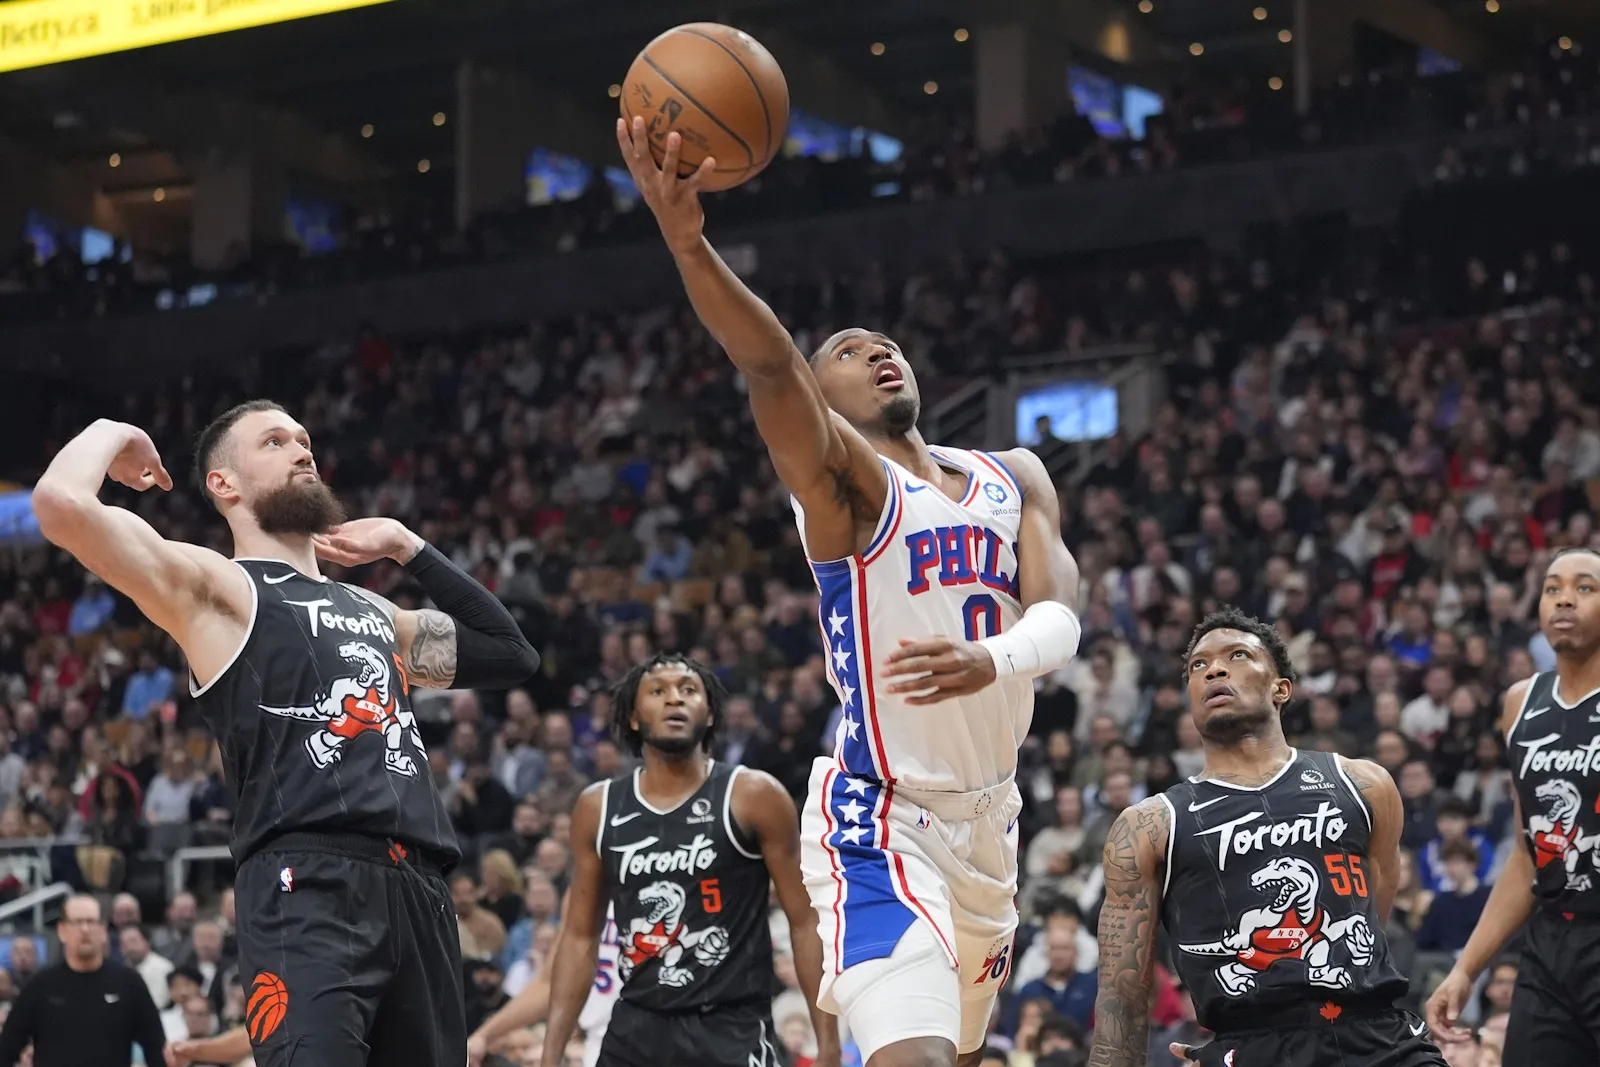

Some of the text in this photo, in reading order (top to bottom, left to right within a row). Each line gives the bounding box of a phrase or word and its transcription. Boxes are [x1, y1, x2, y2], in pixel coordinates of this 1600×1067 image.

[905, 524, 1020, 598] PHL
[283, 598, 395, 644] Toronto
[609, 833, 718, 885] Toronto
[1193, 801, 1348, 872] Toronto
[700, 878, 722, 914] 5
[1324, 853, 1368, 898] 55
[1277, 929, 1304, 938] NOR
[1288, 939, 1299, 950] 19
